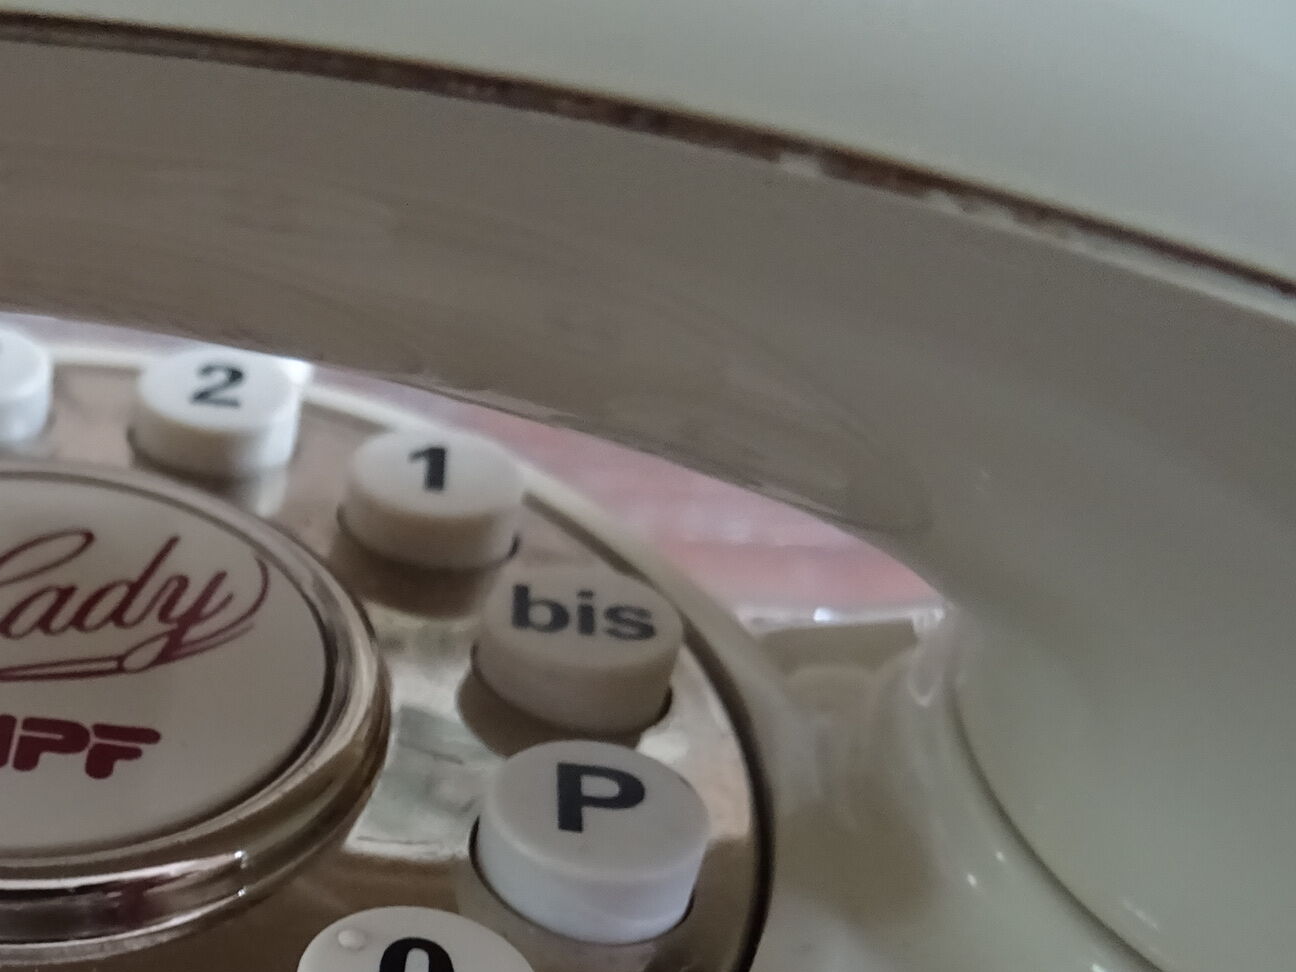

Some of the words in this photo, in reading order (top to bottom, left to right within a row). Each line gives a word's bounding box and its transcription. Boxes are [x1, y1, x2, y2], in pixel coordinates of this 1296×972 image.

[189, 363, 247, 409] 2
[410, 446, 449, 493] 1
[509, 584, 659, 642] bis
[556, 762, 646, 834] P
